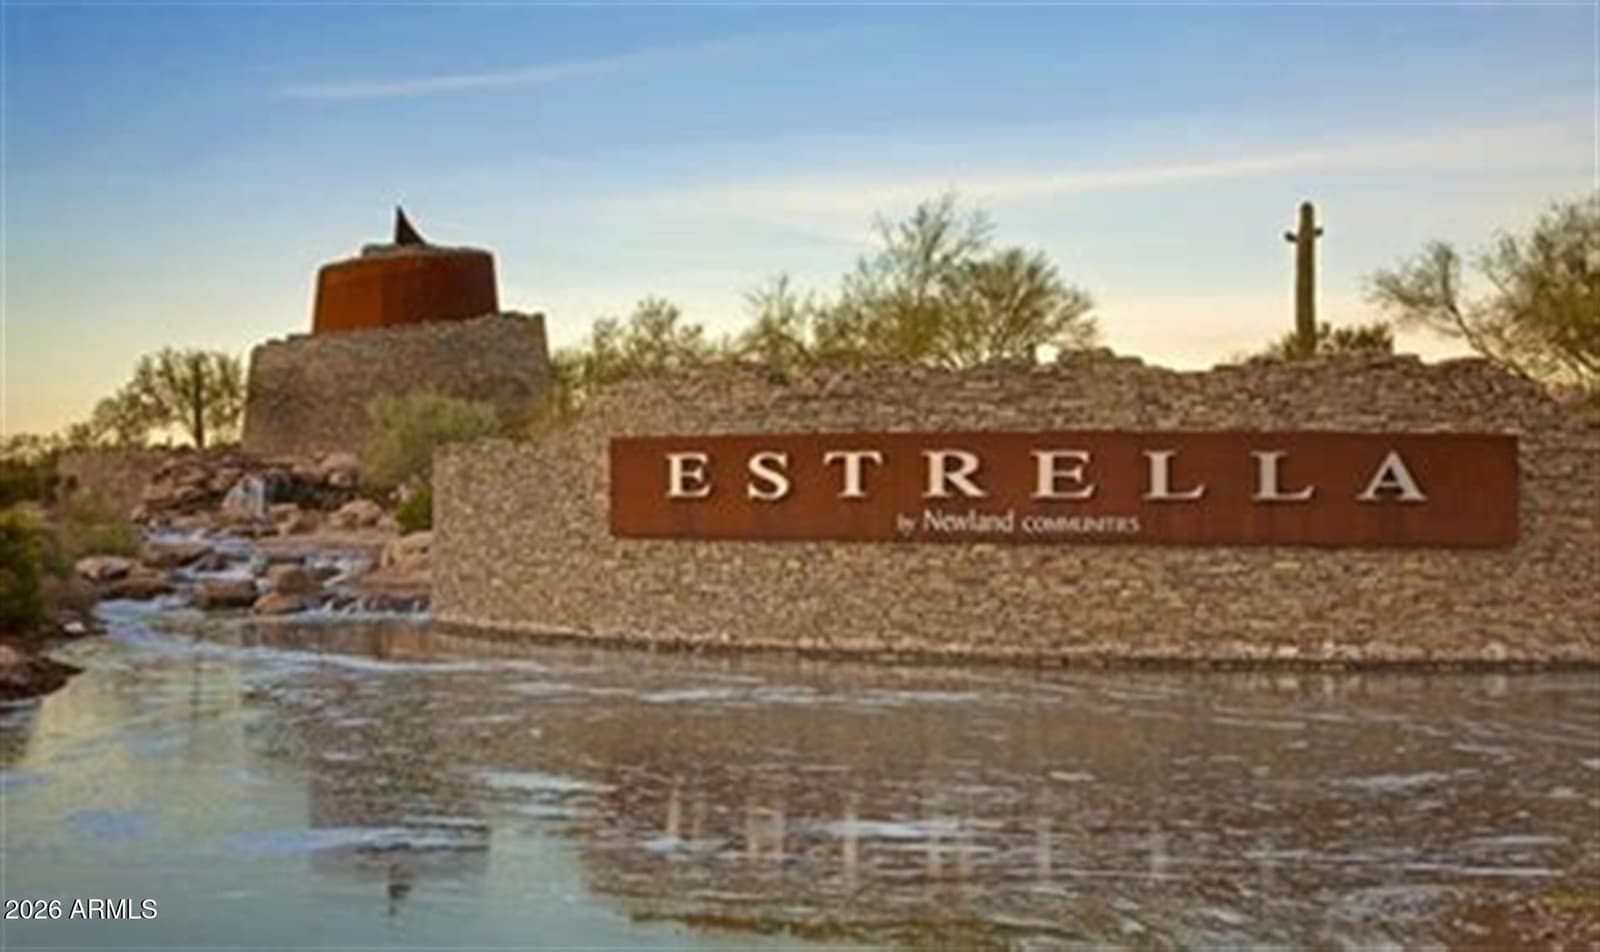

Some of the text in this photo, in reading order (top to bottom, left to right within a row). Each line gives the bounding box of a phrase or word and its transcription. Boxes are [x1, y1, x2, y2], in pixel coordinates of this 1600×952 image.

[665, 448, 1427, 502] ESTRELLA
[923, 508, 1015, 534] Newland
[1021, 515, 1140, 534] COMMUNITIES
